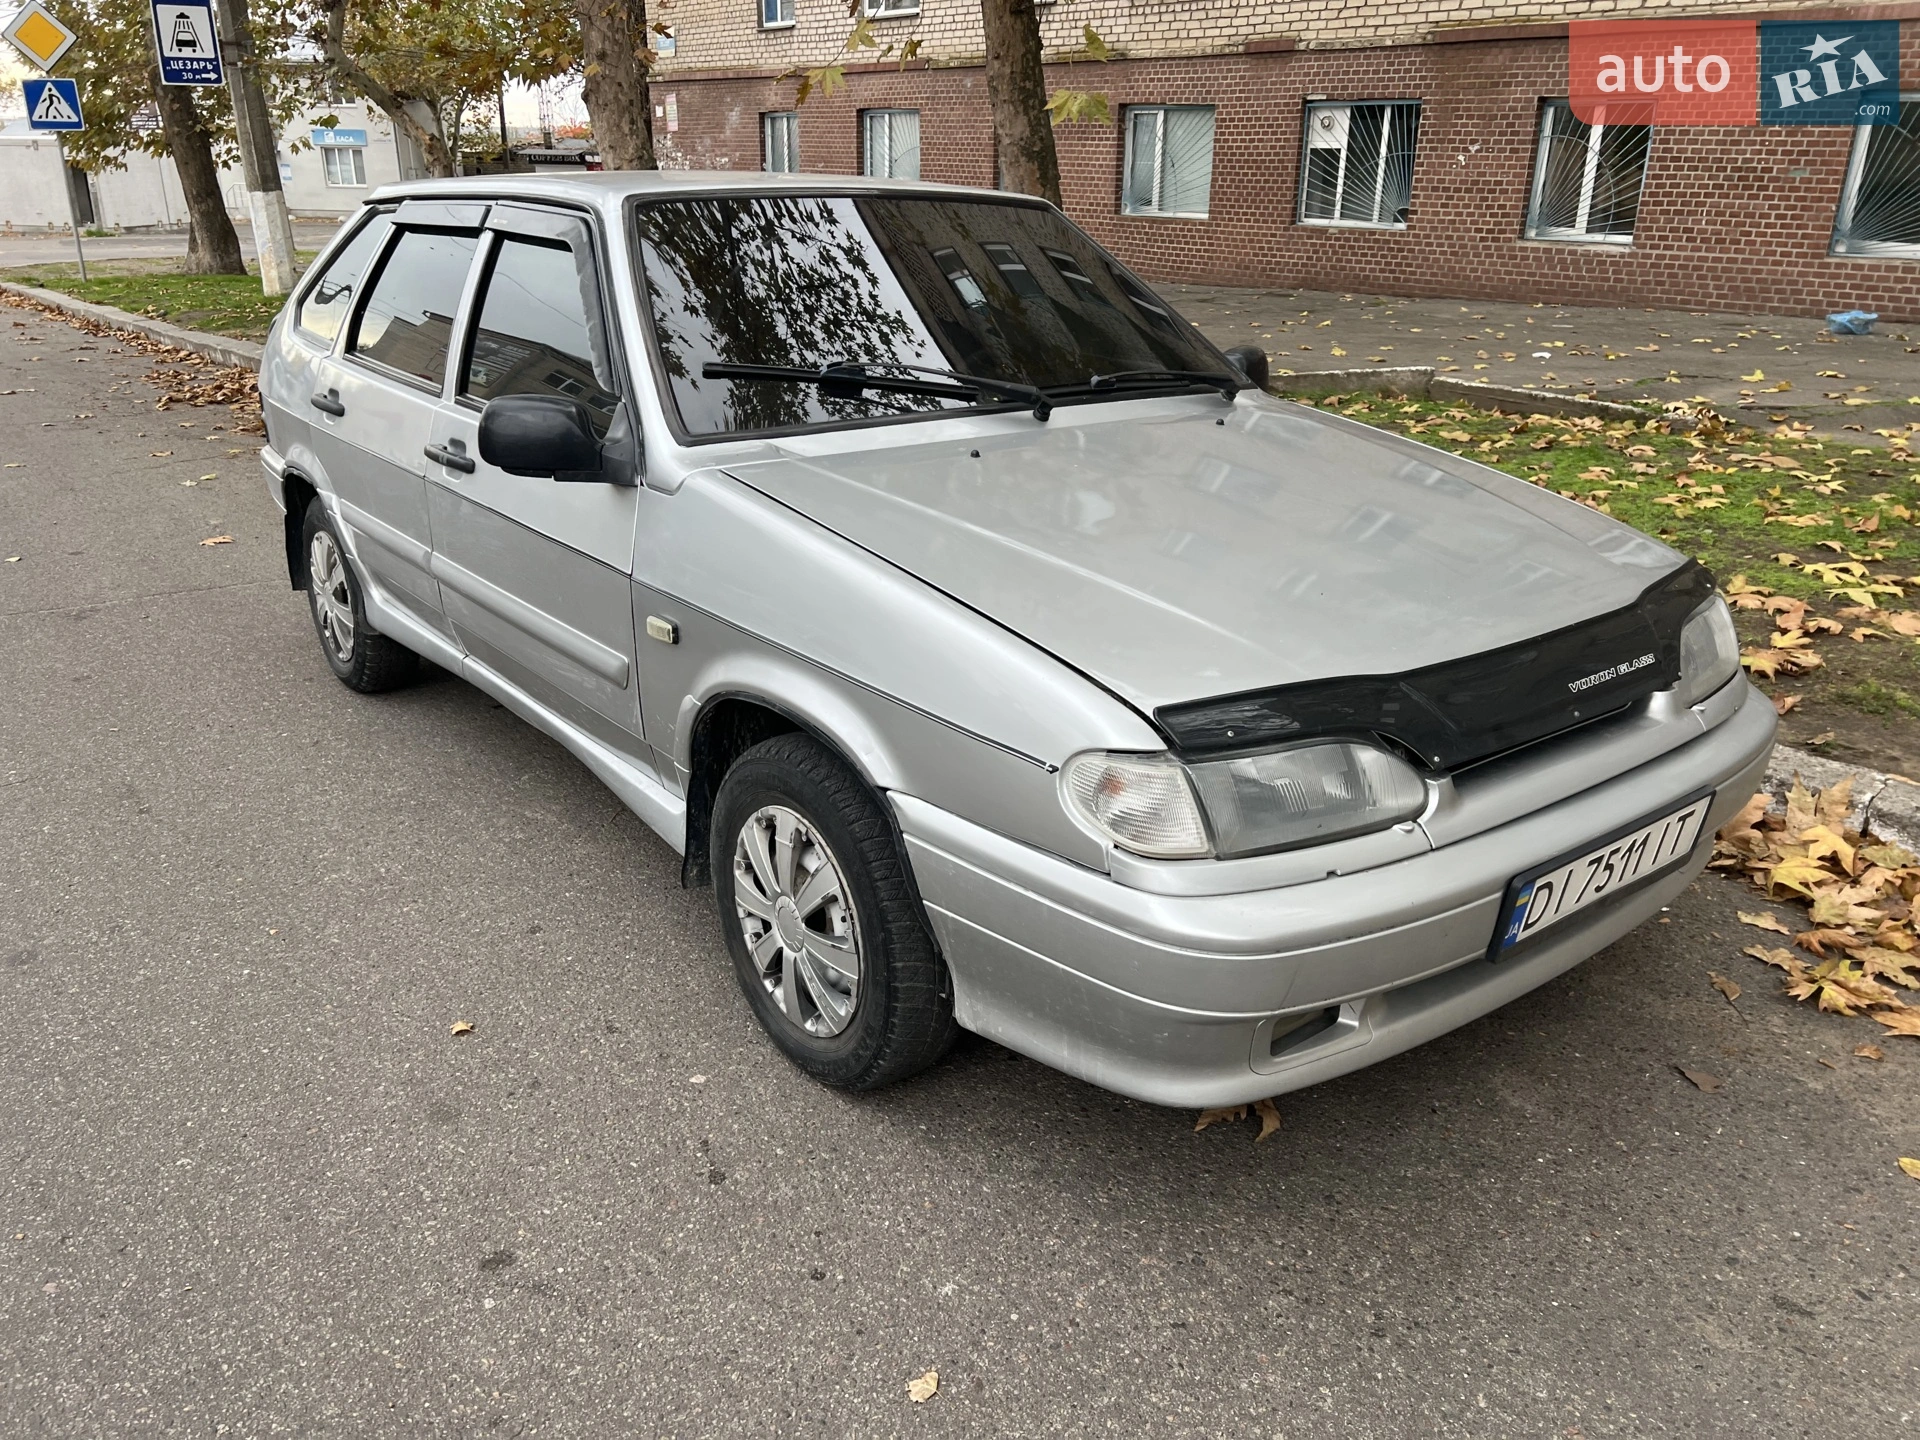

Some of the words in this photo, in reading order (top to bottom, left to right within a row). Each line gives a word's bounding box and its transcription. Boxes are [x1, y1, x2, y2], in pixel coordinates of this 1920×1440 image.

[182, 72, 193, 80] 30
[1568, 667, 1616, 693] VORON
[1617, 653, 1655, 675] GLASS
[1521, 868, 1573, 932] DI
[1573, 831, 1651, 904] 7511
[1651, 808, 1696, 866] IT
